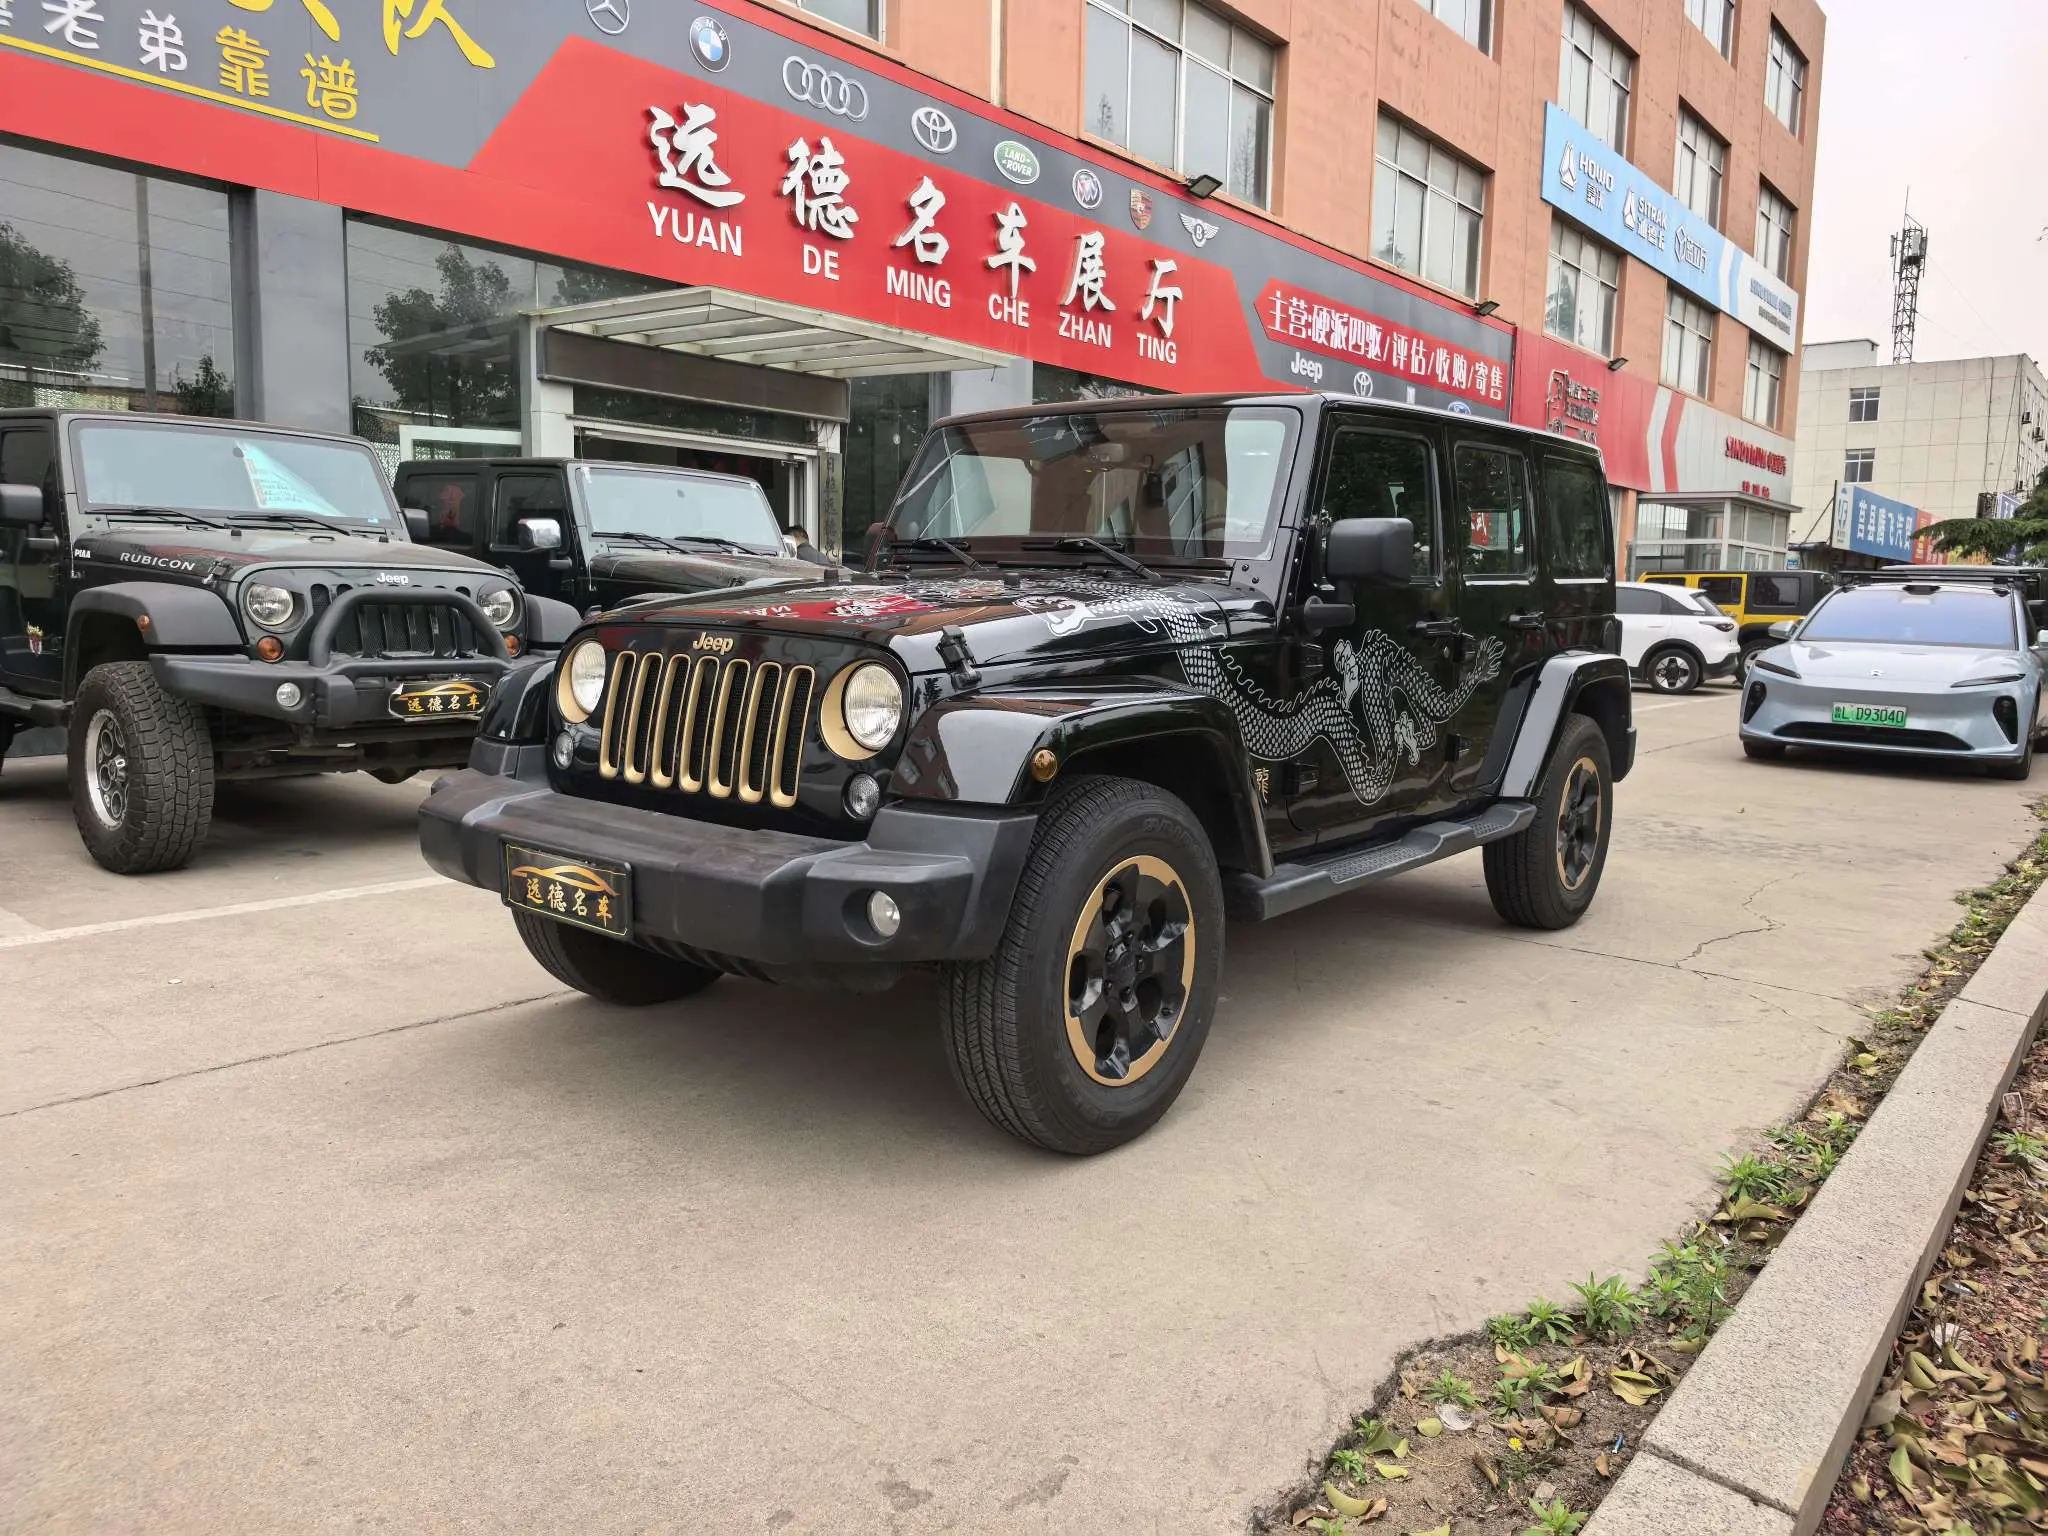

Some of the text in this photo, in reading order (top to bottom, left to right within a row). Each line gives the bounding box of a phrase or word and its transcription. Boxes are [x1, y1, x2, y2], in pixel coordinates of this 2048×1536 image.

[1578, 151, 1614, 193] HOWO
[1638, 196, 1668, 231] SITRAK
[647, 202, 1178, 364] YUAN DE MING CHE ZHAN TING
[1290, 351, 1323, 384] Jeep
[74, 548, 91, 559] PIAA
[120, 552, 196, 571] RUBICON
[376, 572, 409, 585] Jeep
[692, 631, 734, 656] Jeep
